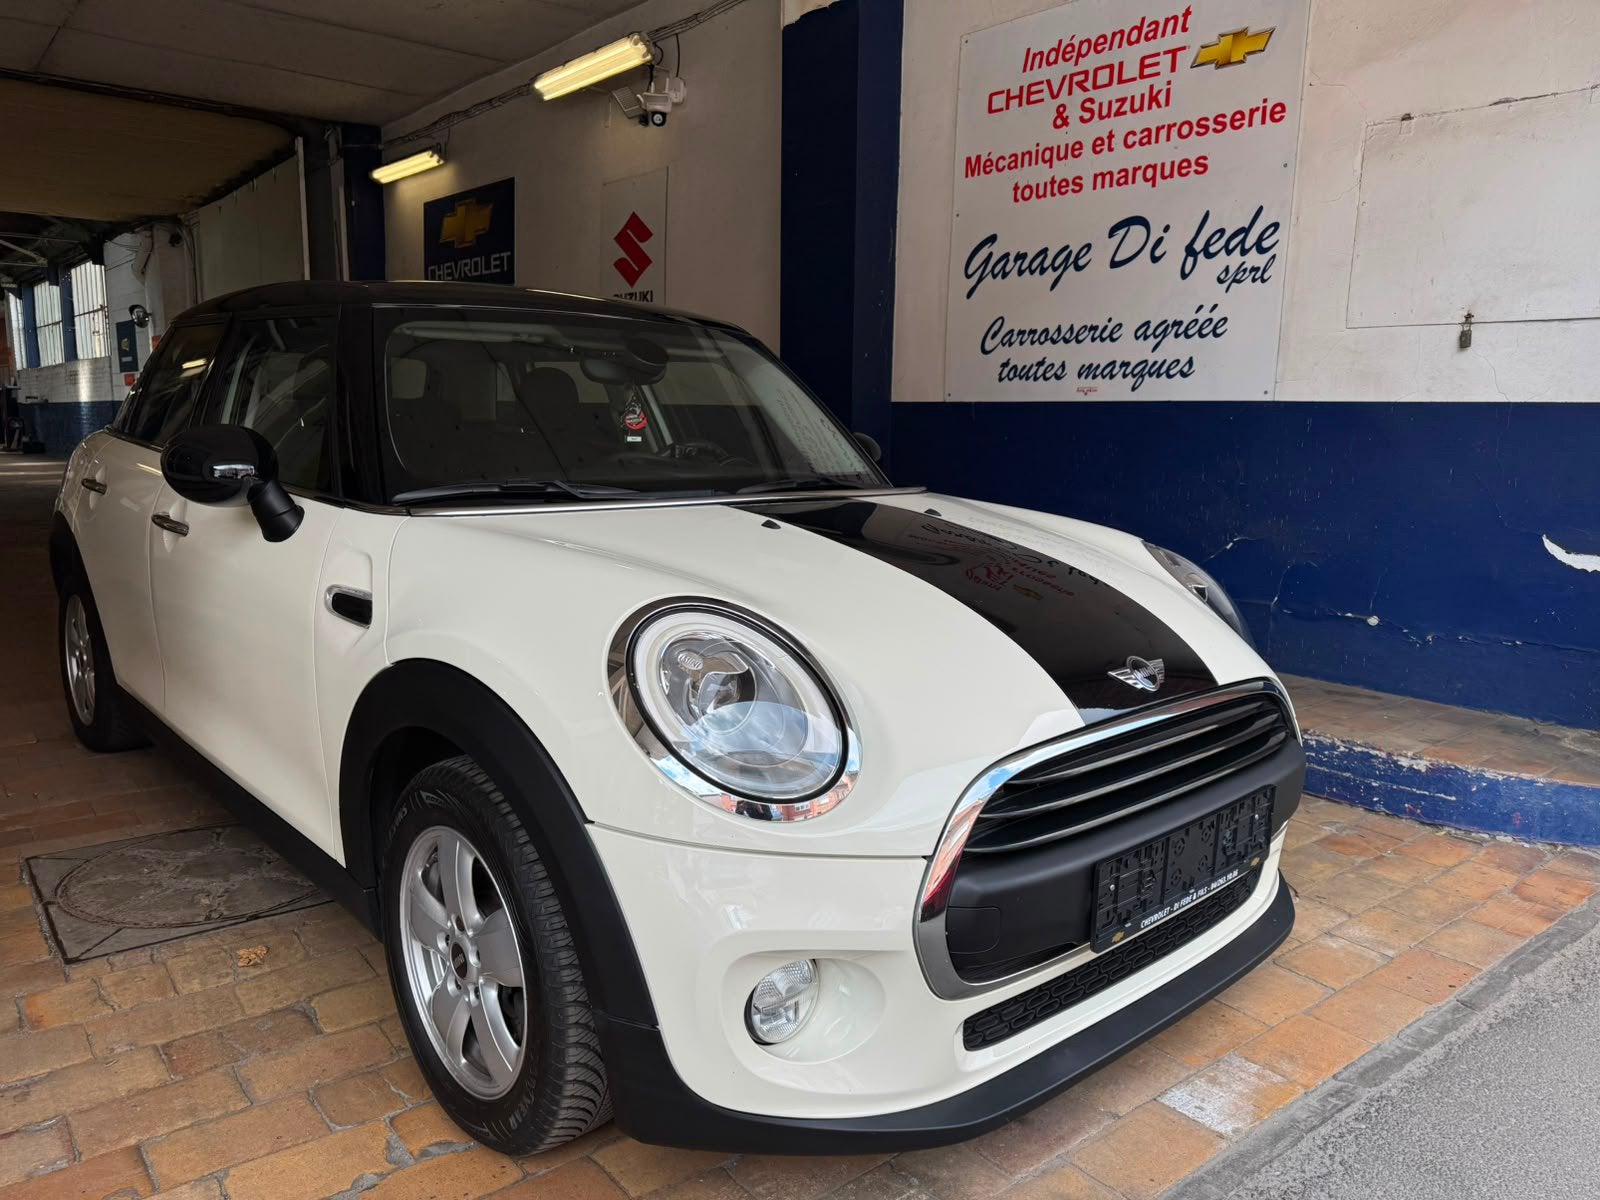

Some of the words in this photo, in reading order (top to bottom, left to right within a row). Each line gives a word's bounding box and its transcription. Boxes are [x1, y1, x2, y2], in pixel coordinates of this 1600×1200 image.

[1022, 5, 1193, 73] Indépendant
[987, 46, 1187, 115] CHEVROLET
[1052, 103, 1071, 130] &
[1078, 80, 1174, 125] Suzuki
[964, 140, 1085, 179] Mécanique
[1091, 130, 1115, 156] et
[1122, 98, 1288, 150] carrosserie
[1012, 174, 1085, 204] toutes
[1092, 154, 1210, 191] marques
[427, 251, 512, 281] CHEVROLET
[963, 233, 1093, 300] Garage
[1107, 215, 1171, 269] Di
[1180, 205, 1281, 281] fede
[1216, 253, 1277, 294] sprl
[979, 315, 1123, 356] Carrosserie
[1133, 303, 1229, 354] agréée
[997, 356, 1068, 384] toutes
[1077, 356, 1196, 393] marques
